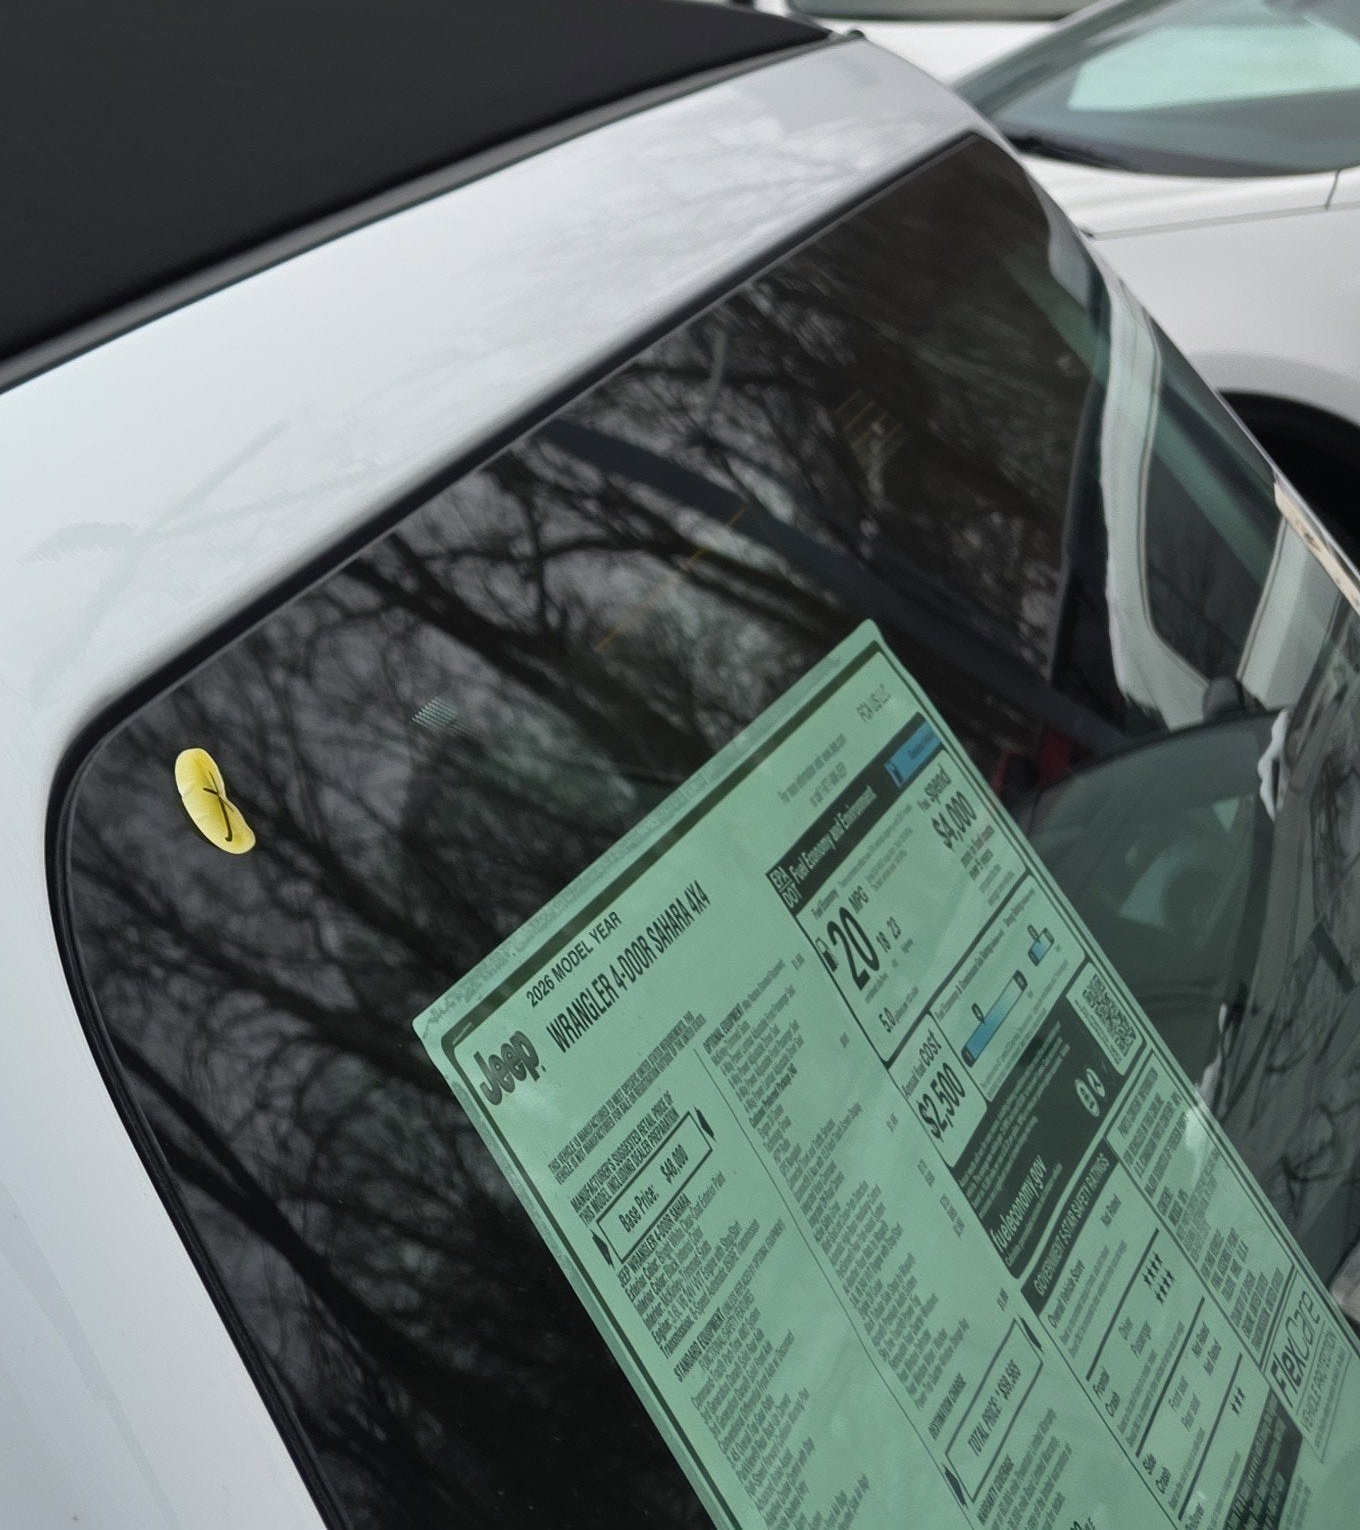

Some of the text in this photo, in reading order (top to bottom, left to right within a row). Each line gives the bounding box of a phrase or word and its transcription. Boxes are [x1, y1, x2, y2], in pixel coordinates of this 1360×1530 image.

[919, 762, 955, 808] spend
[929, 787, 980, 855] $4,000
[768, 864, 789, 889] EPA
[788, 856, 810, 885] Fuel
[800, 828, 838, 873] Economy
[826, 818, 845, 842] and
[836, 782, 877, 830] Environment
[781, 882, 802, 909] DOT
[847, 884, 870, 914] MPG
[885, 915, 902, 940] 23
[524, 909, 622, 1007] 2026 MODEL YEAR
[545, 878, 711, 1054] WRANGLER 4-DOOR SAHARA 4X4
[820, 902, 884, 992] 20
[874, 929, 892, 954] 18
[877, 1006, 897, 1034] 5.0
[915, 1027, 942, 1068] cost
[471, 1029, 544, 1107] Jeep
[913, 1058, 971, 1146] $2,500
[569, 1089, 674, 1213] MANUFACTURER'S SUGGESTED RETAIL PRICE OF
[578, 1105, 680, 1227] THIS MODEL INCLUDING DEALER PREPARATION
[618, 1142, 691, 1234] Base Price: $48,000
[615, 1191, 691, 1289] JEEP WRANGLER 4-DOOR SAHARA
[989, 1149, 1051, 1259] fueleconomy.gov
[1032, 1233, 1067, 1299] GOVERNMENT
[1058, 1210, 1079, 1247] 5-STAR
[1071, 1181, 1093, 1222] SAFETY
[1085, 1149, 1109, 1194] RATINGS
[673, 1306, 726, 1383] STANDARD EQUIPMENT
[1104, 1386, 1121, 1419] Crash
[1130, 1315, 1153, 1363] Passenger
[1267, 1285, 1321, 1409] FlexCare
[1300, 1381, 1321, 1436] VEHICLE
[1312, 1323, 1336, 1393] PROTECTION
[967, 1418, 990, 1459] TOTAL
[980, 1392, 1002, 1432] PRICE:
